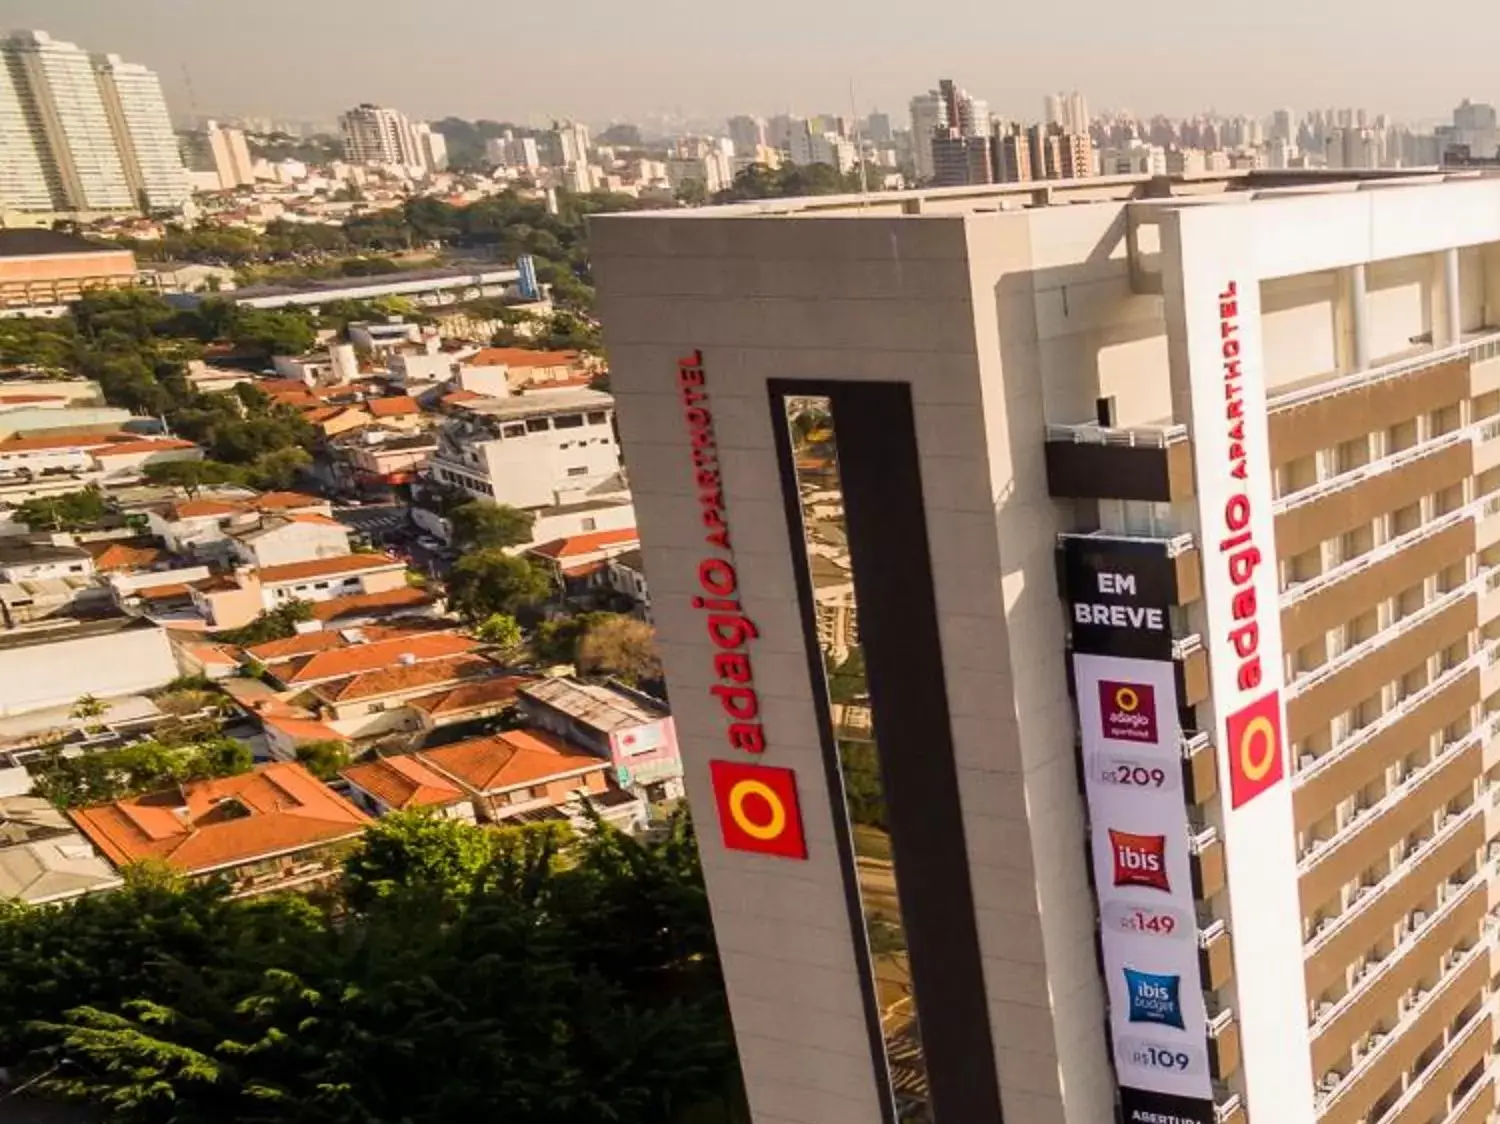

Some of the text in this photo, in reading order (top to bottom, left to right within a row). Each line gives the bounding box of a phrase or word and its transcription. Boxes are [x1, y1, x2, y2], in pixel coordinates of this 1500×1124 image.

[1218, 281, 1261, 691] adagio APARTHOTEL
[678, 349, 767, 755] adagio APARTHOTEL
[1097, 572, 1137, 596] EM
[1074, 602, 1164, 630] BREVE
[1119, 845, 1160, 871] ibis
[1138, 981, 1169, 1001] ibis
[1135, 996, 1174, 1013] budget
